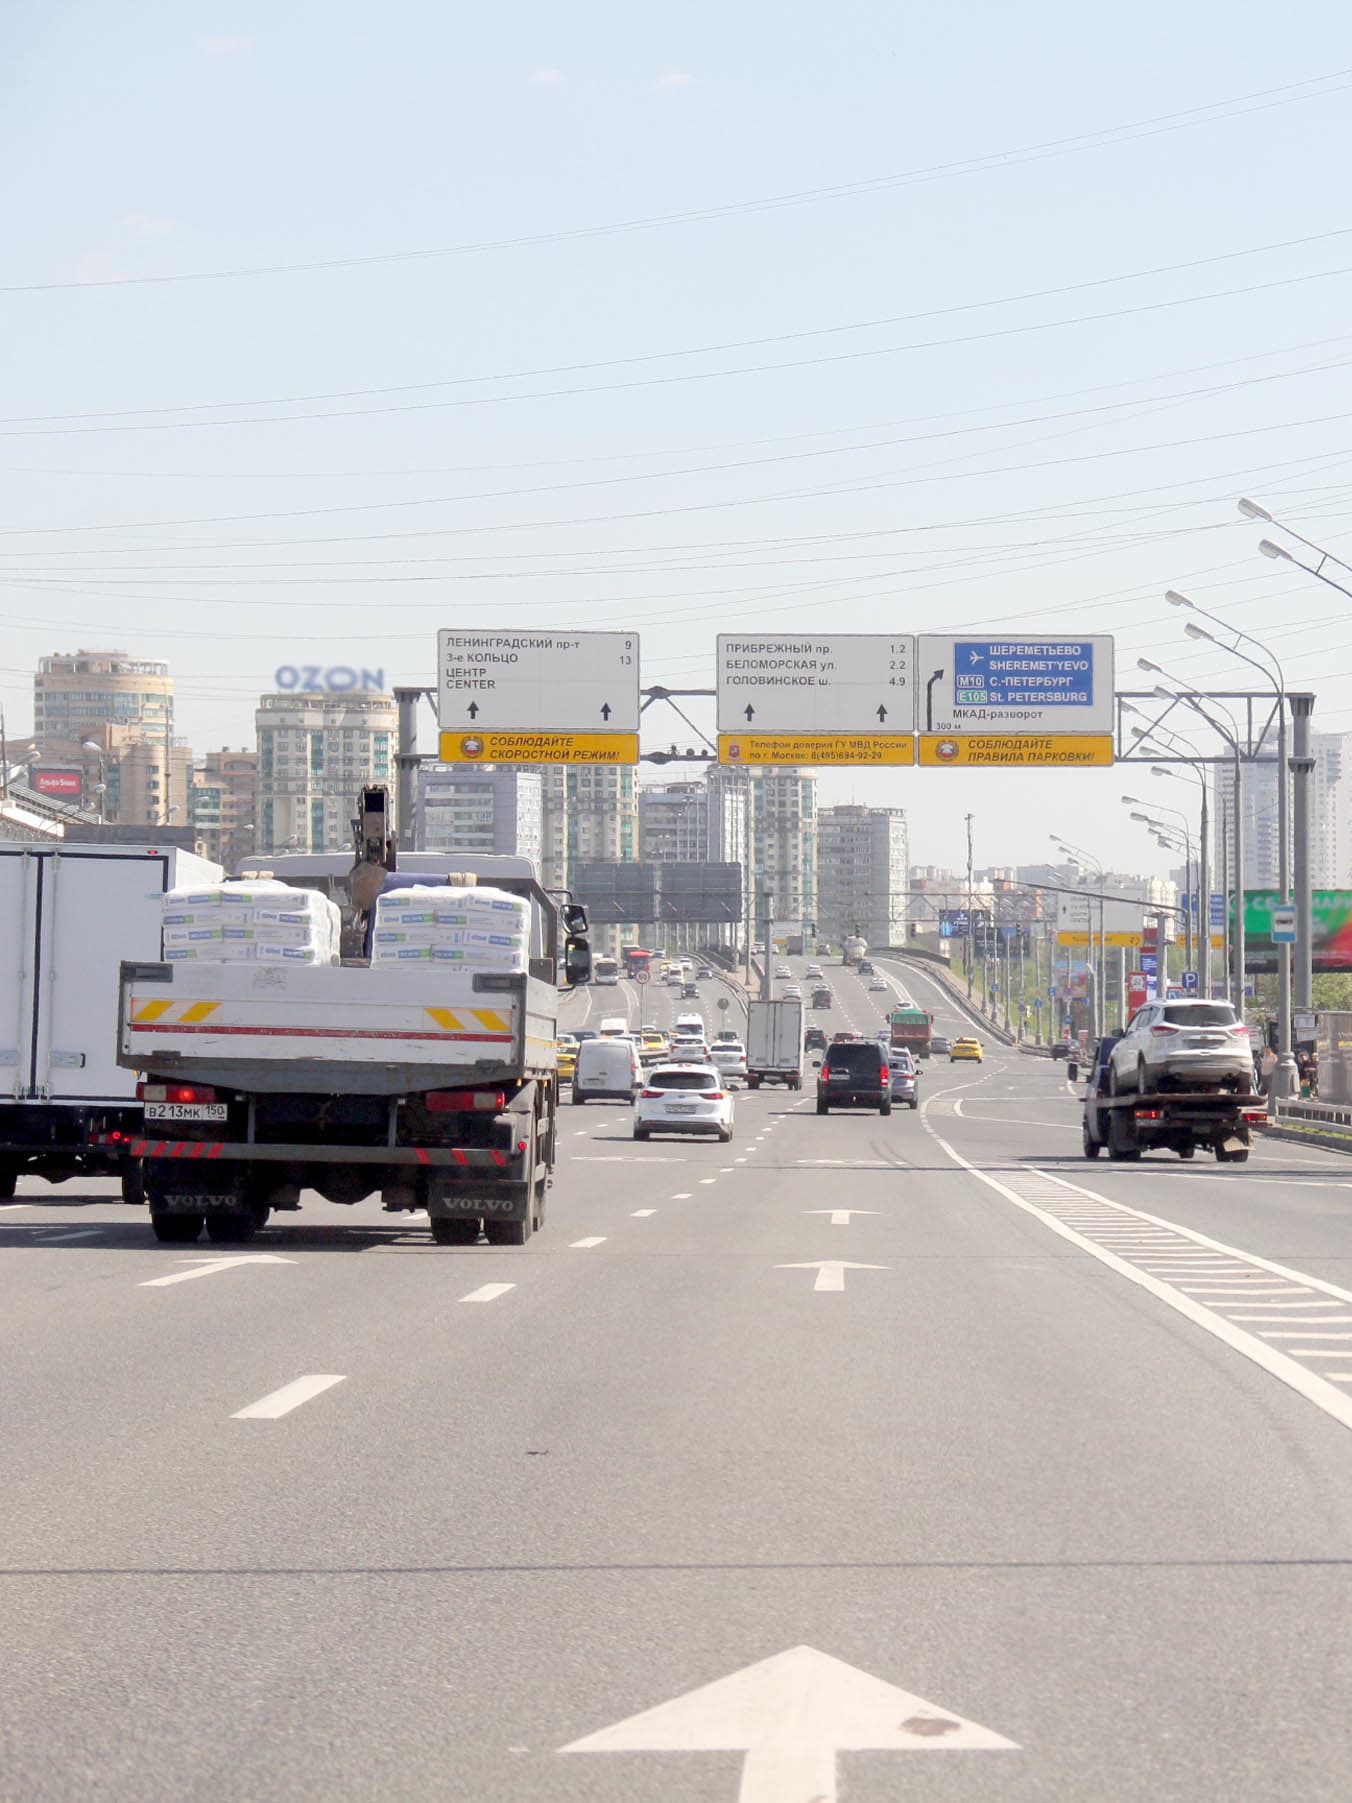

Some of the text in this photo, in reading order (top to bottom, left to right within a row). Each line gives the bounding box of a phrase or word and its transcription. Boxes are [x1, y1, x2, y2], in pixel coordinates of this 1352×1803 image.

[447, 637, 632, 651] ЛЕНИНГРАДСКИЙ пр-т 9
[726, 643, 906, 656] ПРИБРЕЖНЫЙ пр. 1.2
[989, 645, 1081, 656] ШЕРЕМЕТЬЕВО
[447, 653, 632, 665] 3-е КОЛЬЦО 13
[726, 659, 906, 672] БЕЛОМОРСКАЯ ул. 2.2
[274, 665, 385, 692] OZON
[446, 667, 487, 679] ЦЕНТР
[446, 679, 496, 690] CENTER
[726, 676, 906, 687] ГОЛОВИНСКОЕ ш. 4.9
[989, 676, 1074, 687] С.-ПЕТЕРБУРГ
[958, 692, 986, 702] E105
[989, 692, 1088, 702] St. PETERSBURG
[952, 710, 1044, 721] МКАД-разворот
[489, 735, 576, 748] СОБЛЮДАЙТЕ
[749, 740, 907, 750] Телефон доверия ГУ МВД России
[967, 739, 1054, 750] СОБЛЮДАЙТЕ
[489, 749, 620, 761] СКОРОСТНОЙ РЕЖИМ!
[771, 751, 809, 760] Москве:
[967, 751, 1095, 762] ПРАВИЛА ПАРКОВКИ!
[1185, 973, 1196, 987] P
[205, 1105, 225, 1115] 150
[163, 1194, 237, 1206] VOLVO
[441, 1197, 514, 1211] VOLVO
